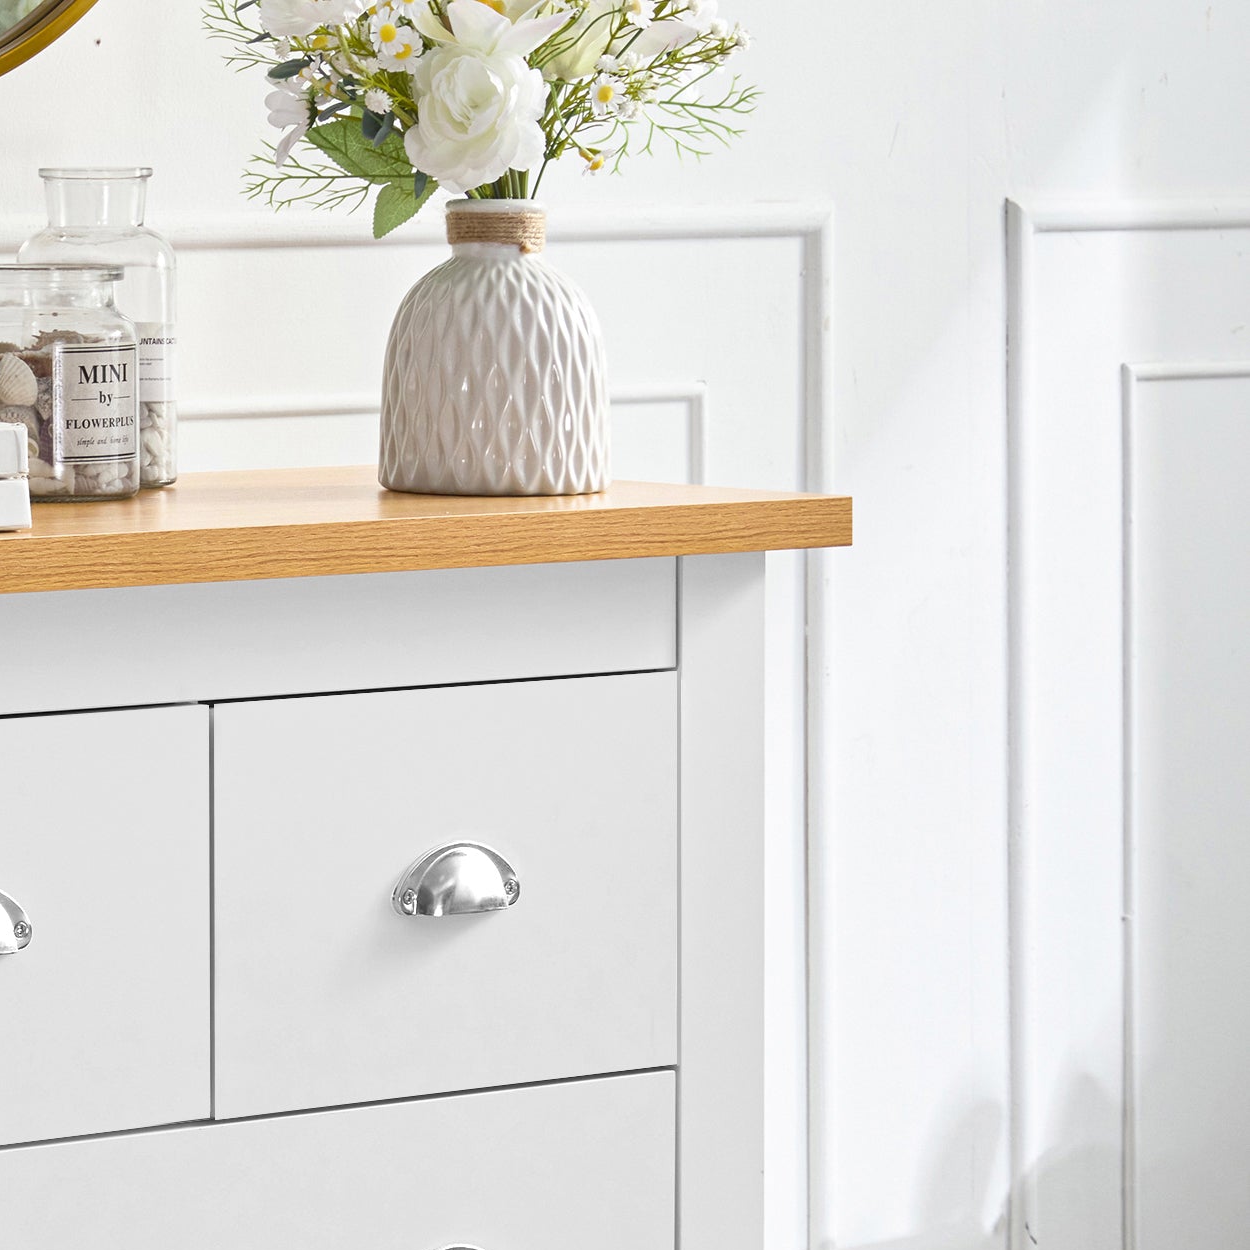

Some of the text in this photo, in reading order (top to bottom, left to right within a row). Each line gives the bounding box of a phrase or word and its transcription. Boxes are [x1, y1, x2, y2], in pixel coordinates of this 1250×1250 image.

[78, 363, 128, 385] MINI
[99, 391, 113, 406] by
[65, 415, 134, 430] FLOWERPLUS
[76, 436, 95, 447] simple
[97, 437, 107, 445] and
